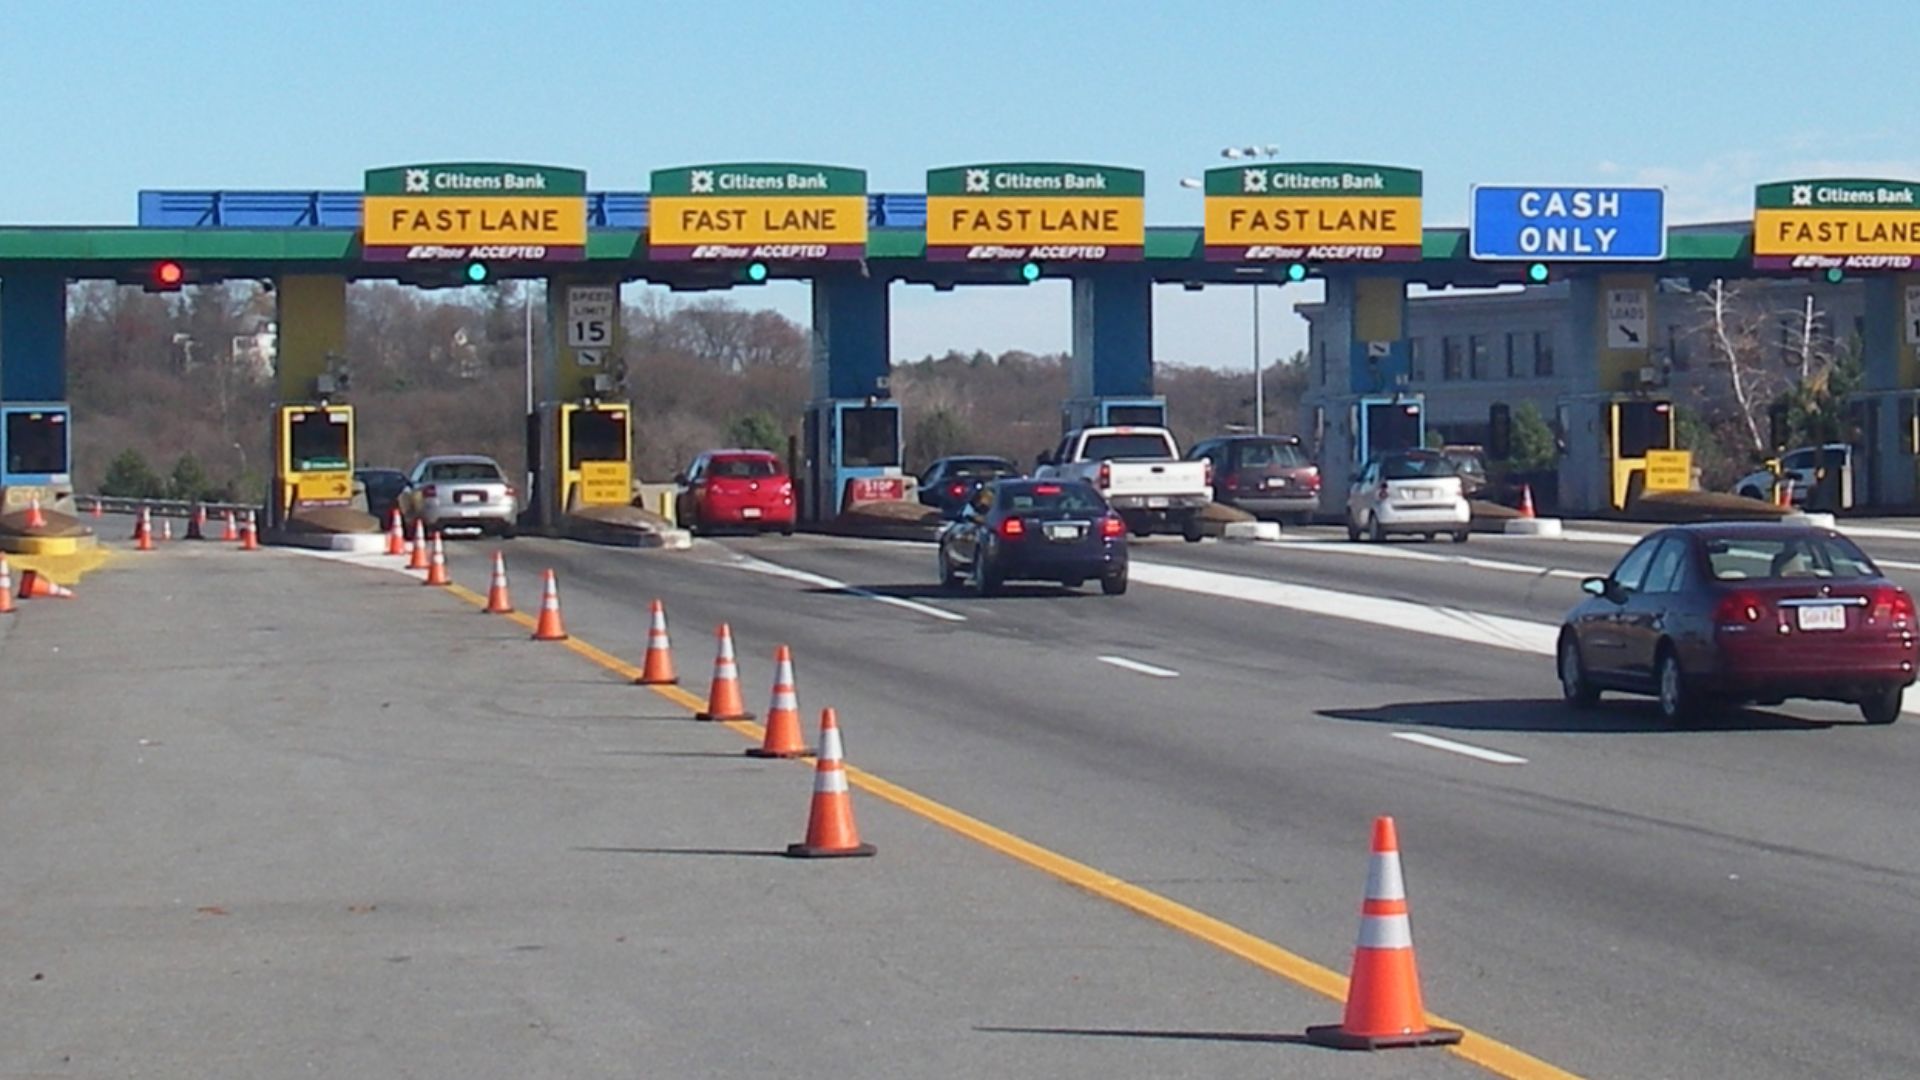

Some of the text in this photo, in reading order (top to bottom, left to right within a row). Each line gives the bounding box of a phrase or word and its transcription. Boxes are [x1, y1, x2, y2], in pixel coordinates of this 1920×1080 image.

[435, 173, 545, 188] Citizens Bank
[719, 173, 827, 189] Citizens Bank
[995, 173, 1105, 188] Citizens Bank
[1273, 173, 1383, 188] Citizens Bank
[1817, 188, 1912, 202] Citizens Bank
[1521, 192, 1618, 217] CASH
[393, 210, 558, 231] FAST LANE
[683, 209, 836, 230] FAST LANE
[953, 210, 1118, 231] FAST LANE
[1231, 210, 1396, 231] FAST LANE
[1521, 227, 1616, 252] ONLY
[1780, 222, 1920, 242] FAST LANE
[469, 246, 545, 258] ACCEPTED
[752, 245, 827, 257] ACCEPTED
[1029, 246, 1105, 258] ACCEPTED
[1307, 246, 1383, 258] ACCEPTED
[1846, 256, 1911, 267] ACCEPTED
[574, 306, 607, 316] LIMIT
[577, 321, 604, 341] 15
